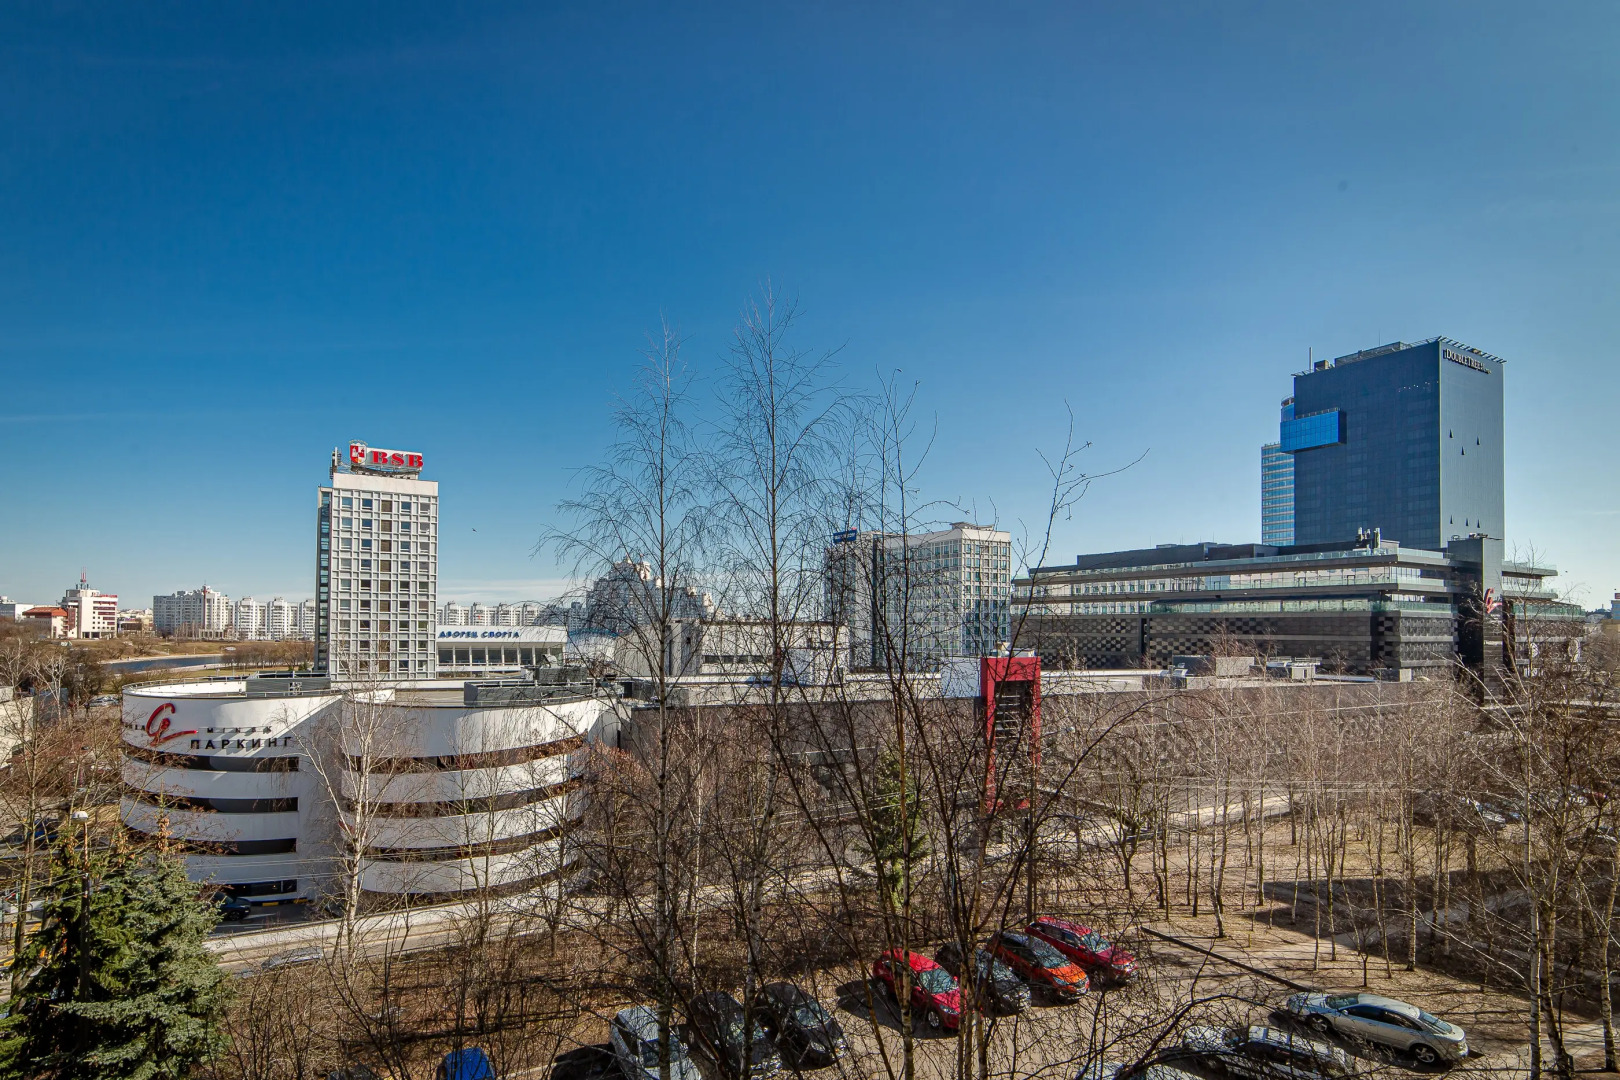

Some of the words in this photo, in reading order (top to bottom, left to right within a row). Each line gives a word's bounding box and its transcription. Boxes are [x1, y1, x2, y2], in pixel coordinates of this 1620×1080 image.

[371, 450, 424, 468] BSB
[438, 631, 478, 639] ДВОРЕЦ
[481, 631, 520, 639] СПОРТА
[207, 726, 272, 734] MINSK
[190, 736, 292, 750] ПАРКИНГ
